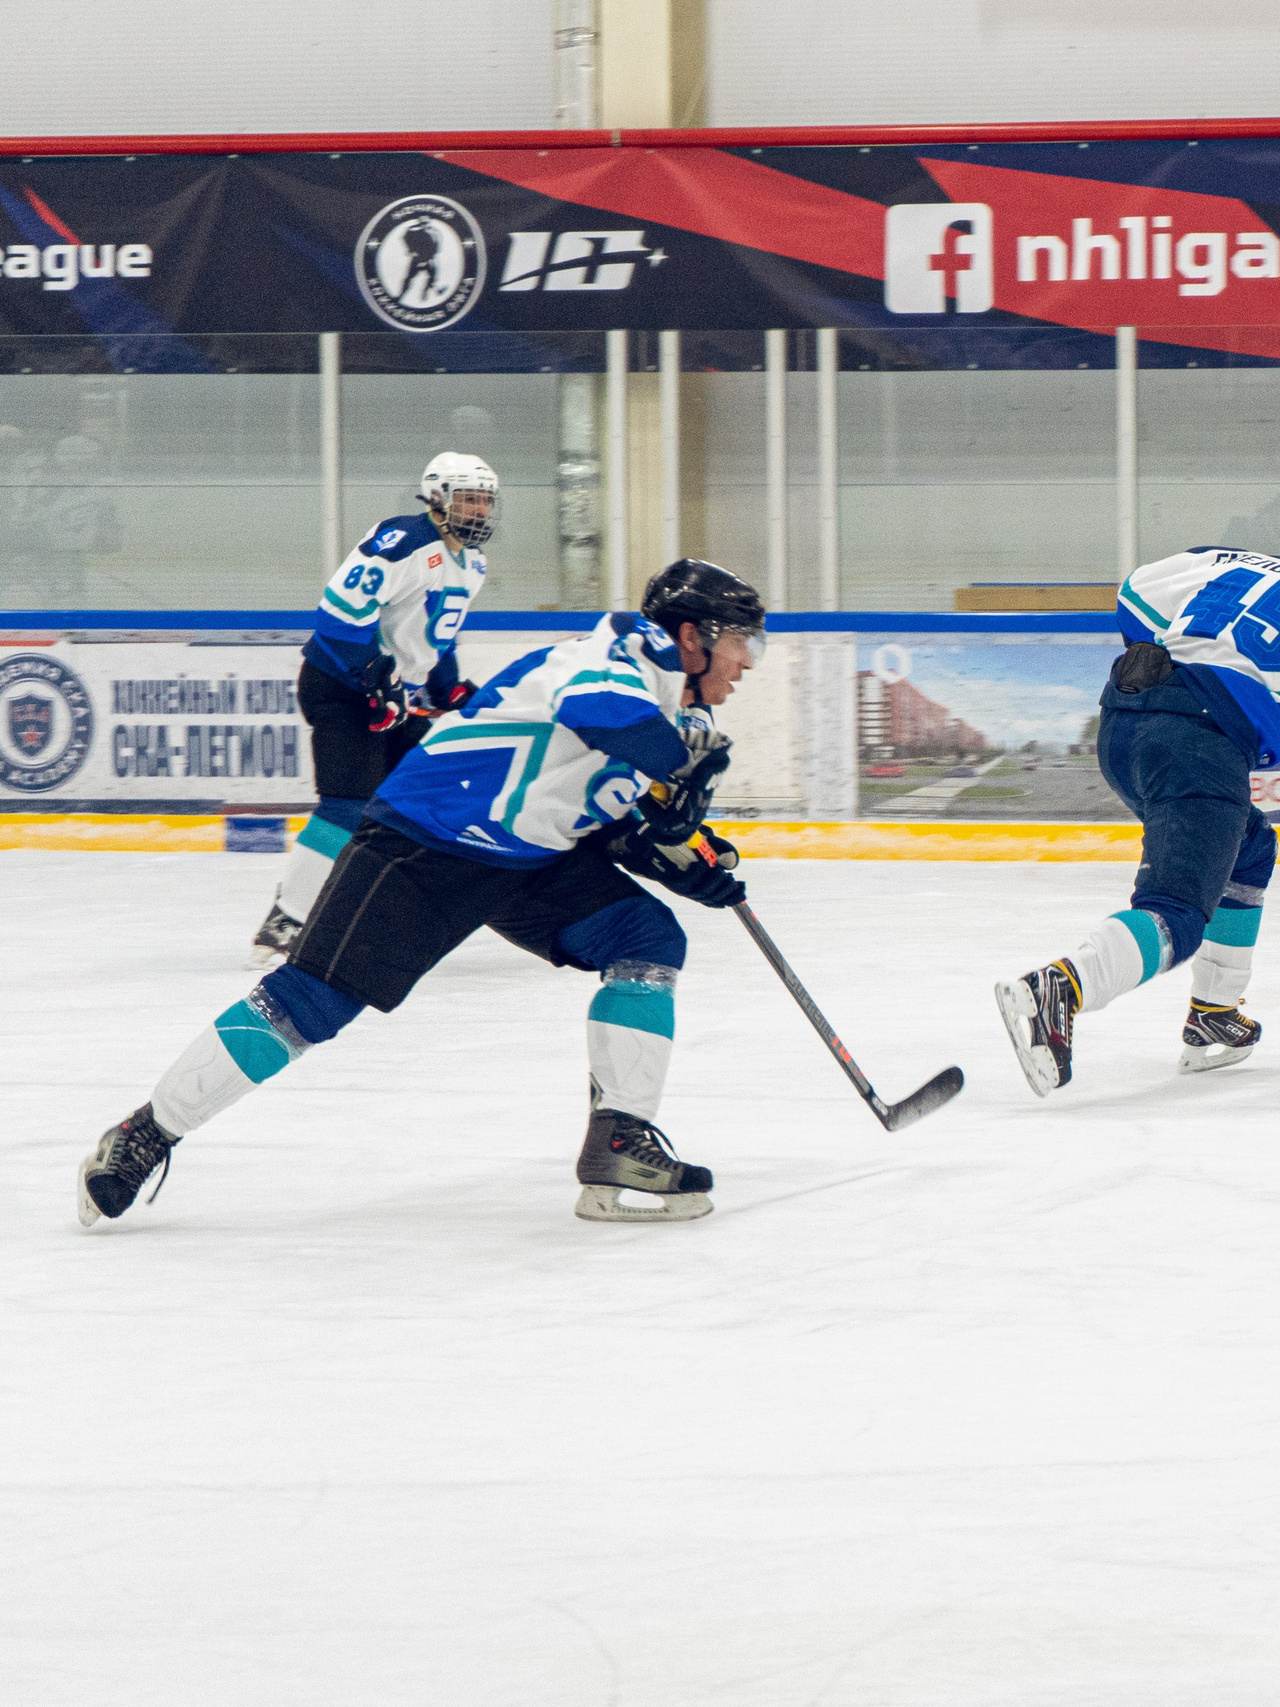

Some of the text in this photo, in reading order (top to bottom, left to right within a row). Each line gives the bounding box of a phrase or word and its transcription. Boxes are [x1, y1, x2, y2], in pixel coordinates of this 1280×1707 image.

[0, 243, 153, 291] ague
[343, 564, 385, 596] 83
[112, 724, 299, 778] СКА-ЛЕГИОН
[1225, 1024, 1245, 1037] CCM
